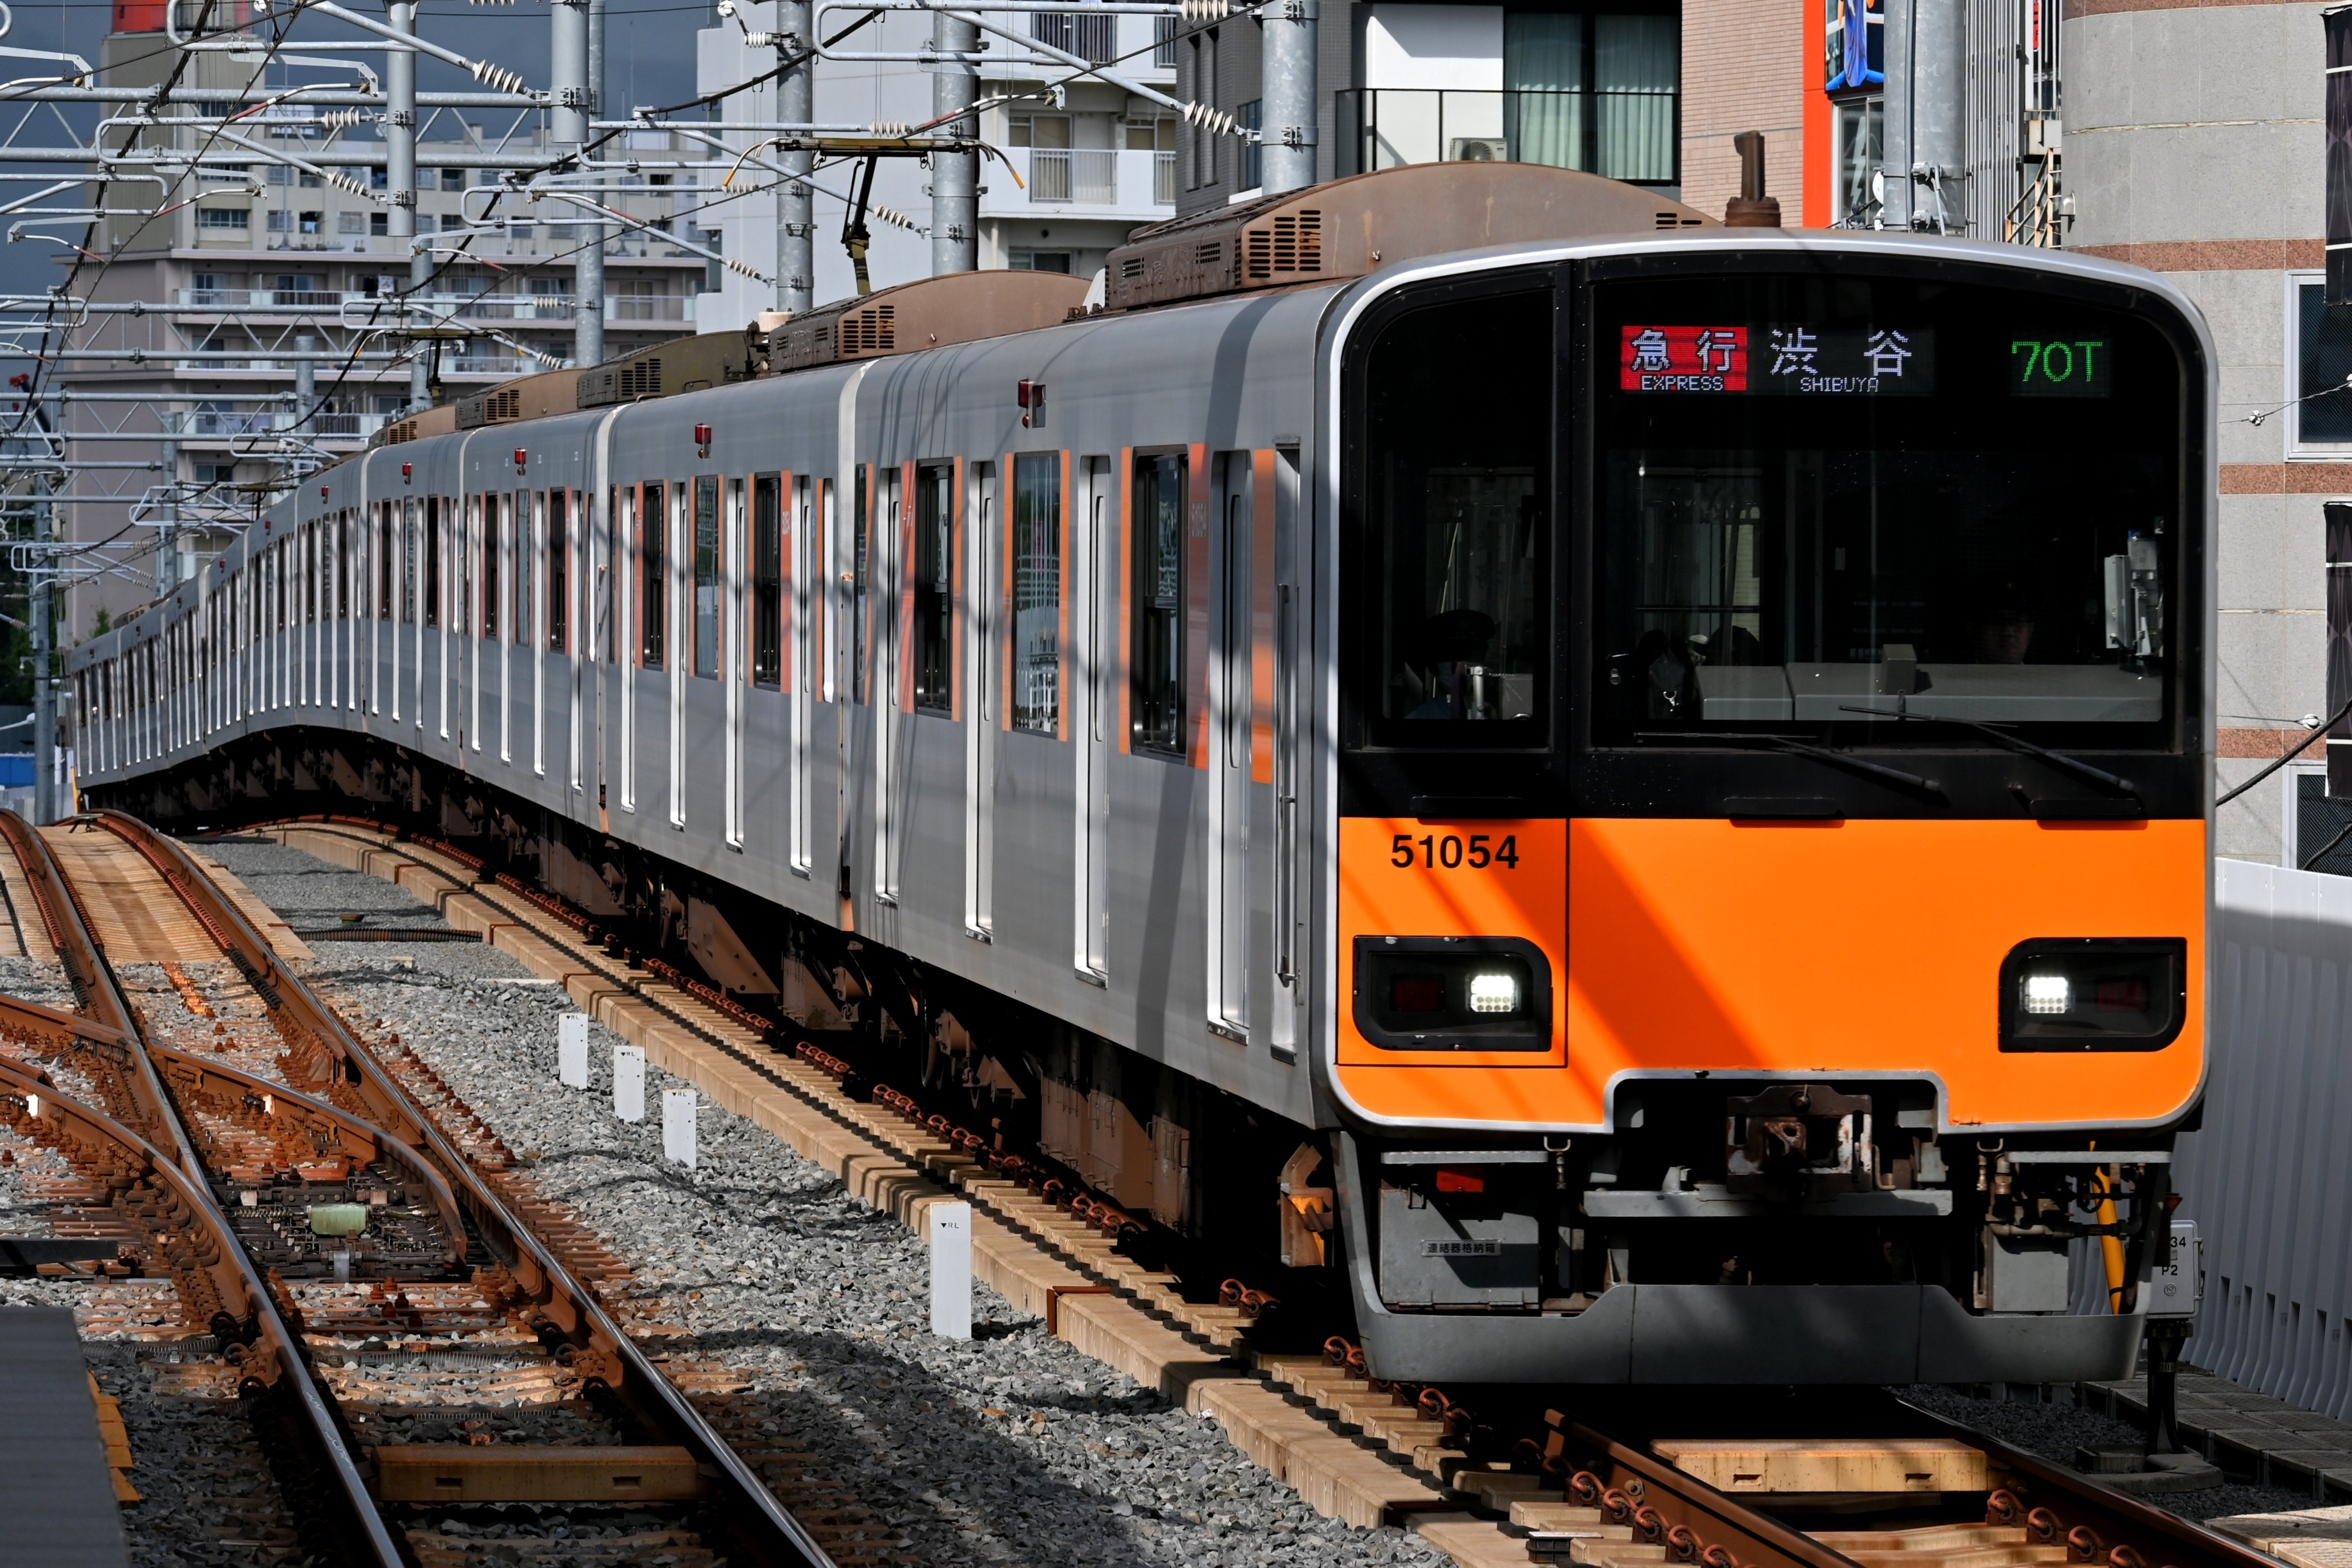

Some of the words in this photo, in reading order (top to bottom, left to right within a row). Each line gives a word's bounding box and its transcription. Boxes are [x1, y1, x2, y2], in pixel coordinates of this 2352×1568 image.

[1632, 330, 1736, 371] 急行
[1770, 327, 1912, 376] 渋谷
[2012, 341, 2103, 382] 70T
[1642, 375, 1723, 390] EXPRESS
[1800, 377, 1879, 392] SHIBUYA
[1391, 834, 1520, 869] 51054
[1428, 1243, 1495, 1253] 連結器格納箱
[2162, 1264, 2178, 1276] P2
